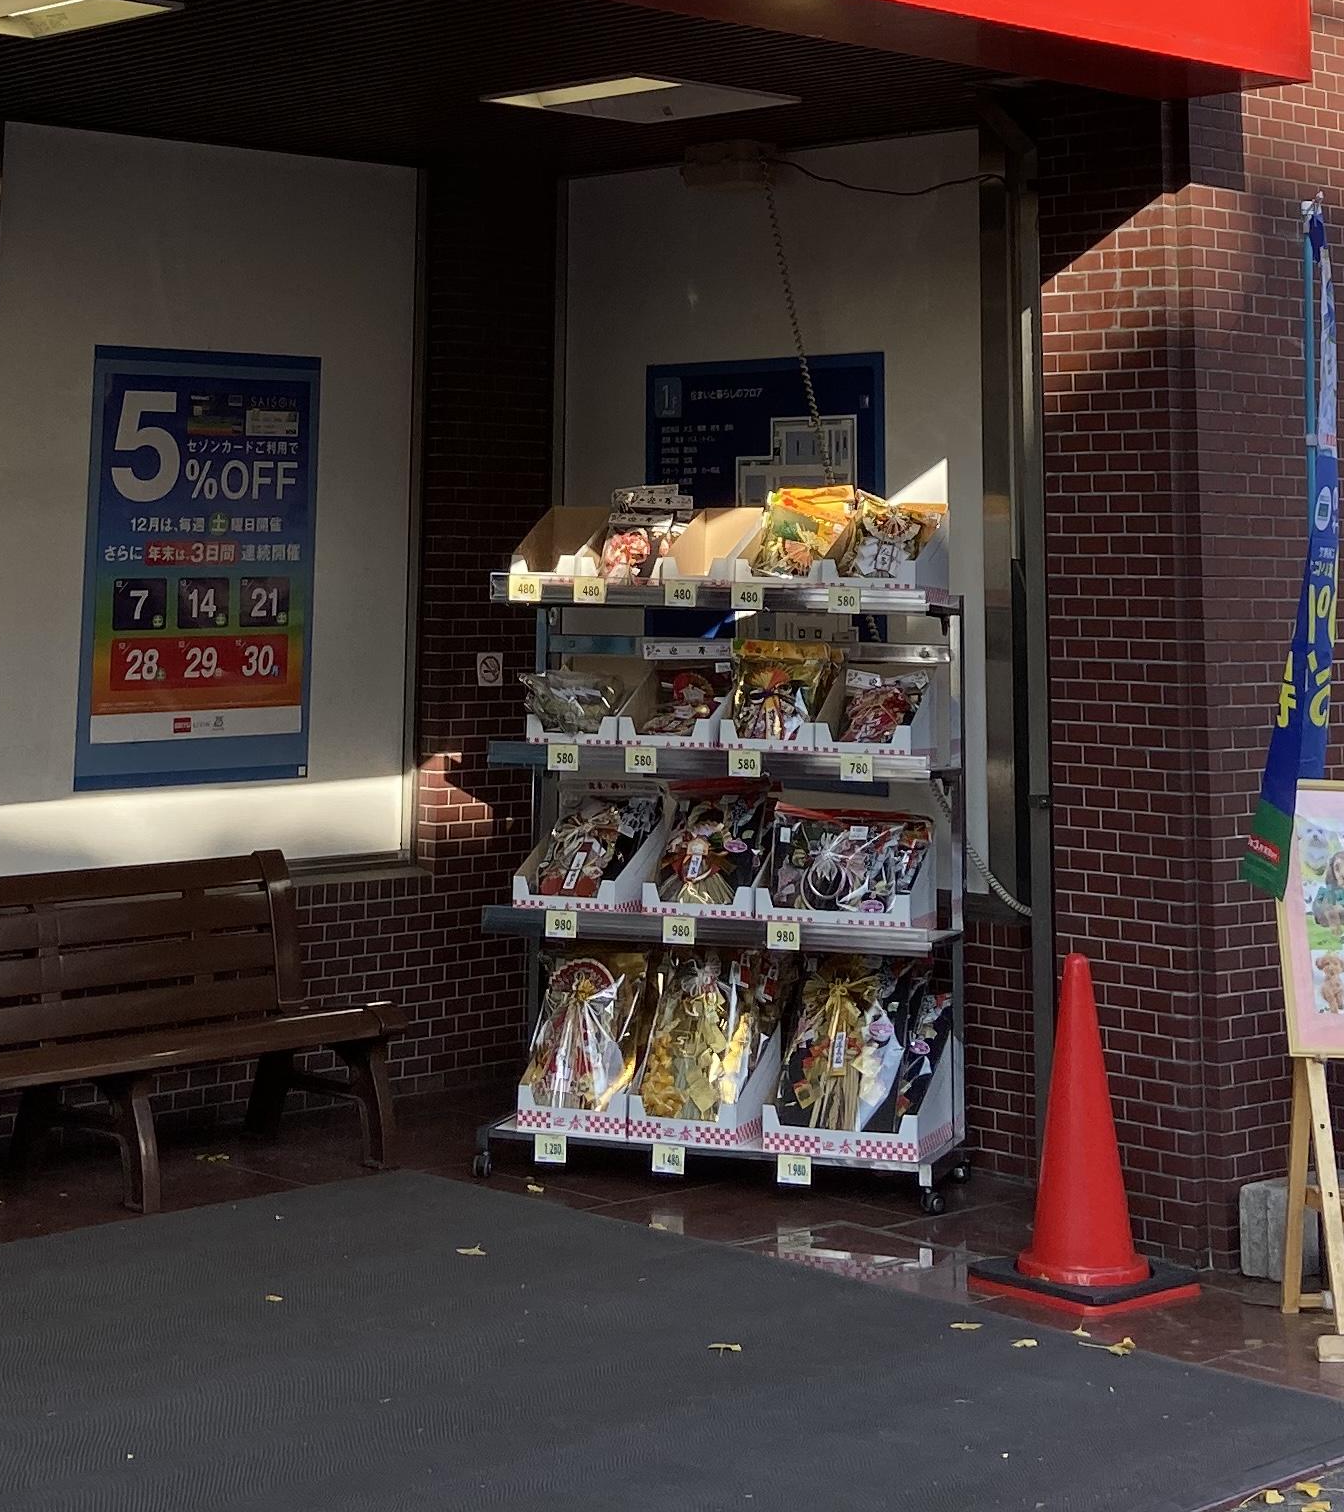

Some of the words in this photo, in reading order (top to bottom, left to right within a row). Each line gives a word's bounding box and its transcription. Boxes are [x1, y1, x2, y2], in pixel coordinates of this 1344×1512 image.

[111, 390, 181, 503] 5
[185, 459, 299, 500] %OFF
[187, 439, 299, 455] セゾンカードご利用で
[516, 583, 536, 596] 480
[582, 585, 600, 597] 480
[673, 589, 691, 600] 480
[740, 591, 758, 603] 480
[837, 596, 855, 607] 580
[124, 648, 159, 681] 28
[184, 646, 218, 678] 29
[242, 645, 274, 677] 30
[556, 752, 573, 765] 580
[633, 755, 651, 767] 580
[738, 758, 755, 771] 580
[850, 763, 868, 775] 780
[554, 919, 572, 931] 980
[672, 925, 690, 937] 980
[776, 930, 794, 943] 980
